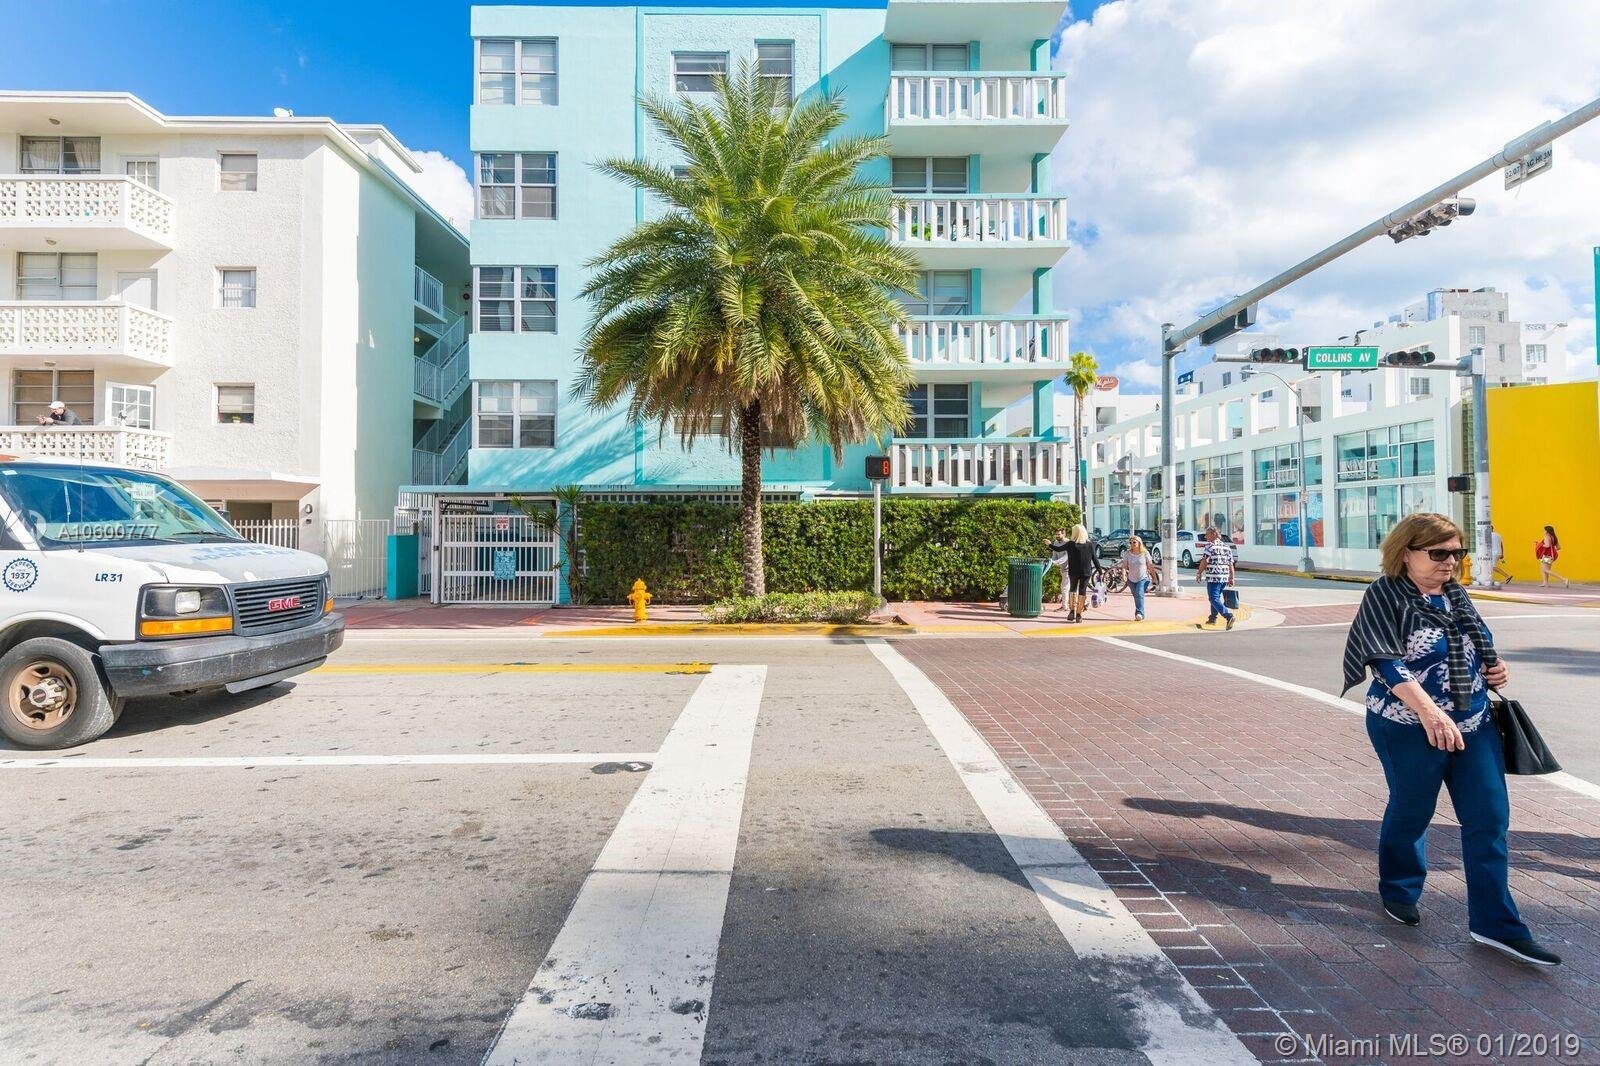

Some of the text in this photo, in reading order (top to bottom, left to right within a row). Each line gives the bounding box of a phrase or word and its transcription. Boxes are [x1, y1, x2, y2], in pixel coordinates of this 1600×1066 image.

[1315, 352, 1371, 363] COLLINS AV
[11, 572, 31, 580] 1937
